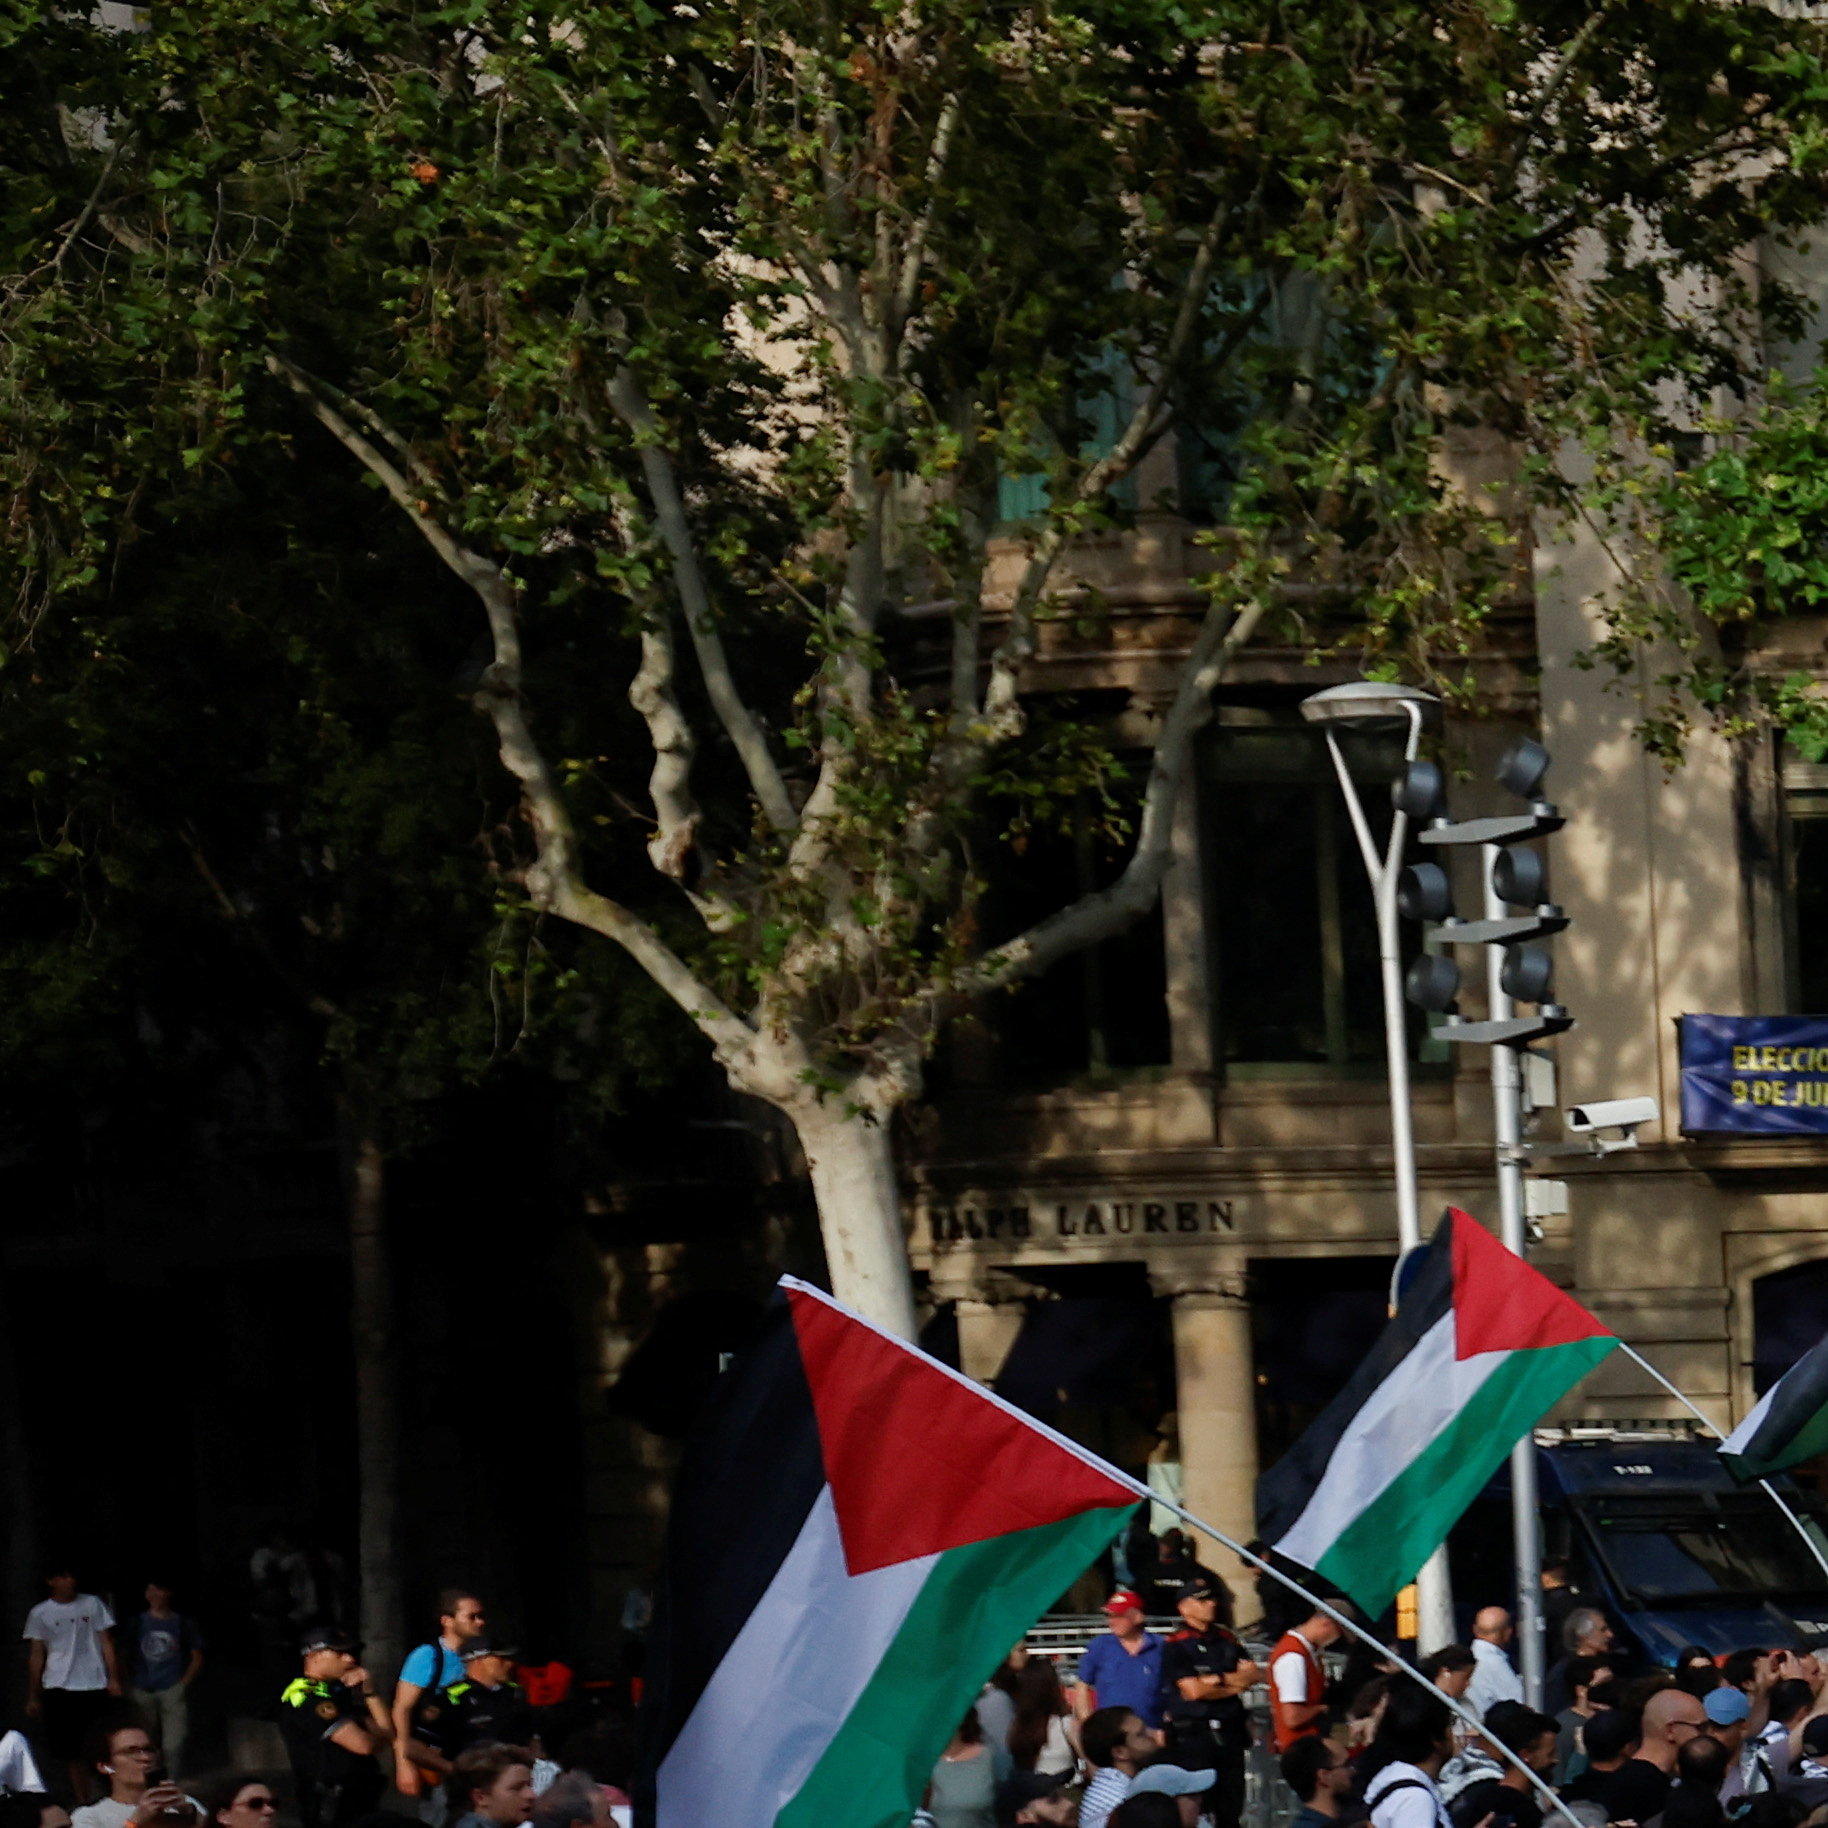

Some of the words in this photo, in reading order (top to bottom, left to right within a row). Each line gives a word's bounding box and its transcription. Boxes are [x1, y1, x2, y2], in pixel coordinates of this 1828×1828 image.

[1732, 1080, 1748, 1104] 9
[1753, 1080, 1787, 1106] DE
[1057, 1201, 1235, 1236] LAUREN
